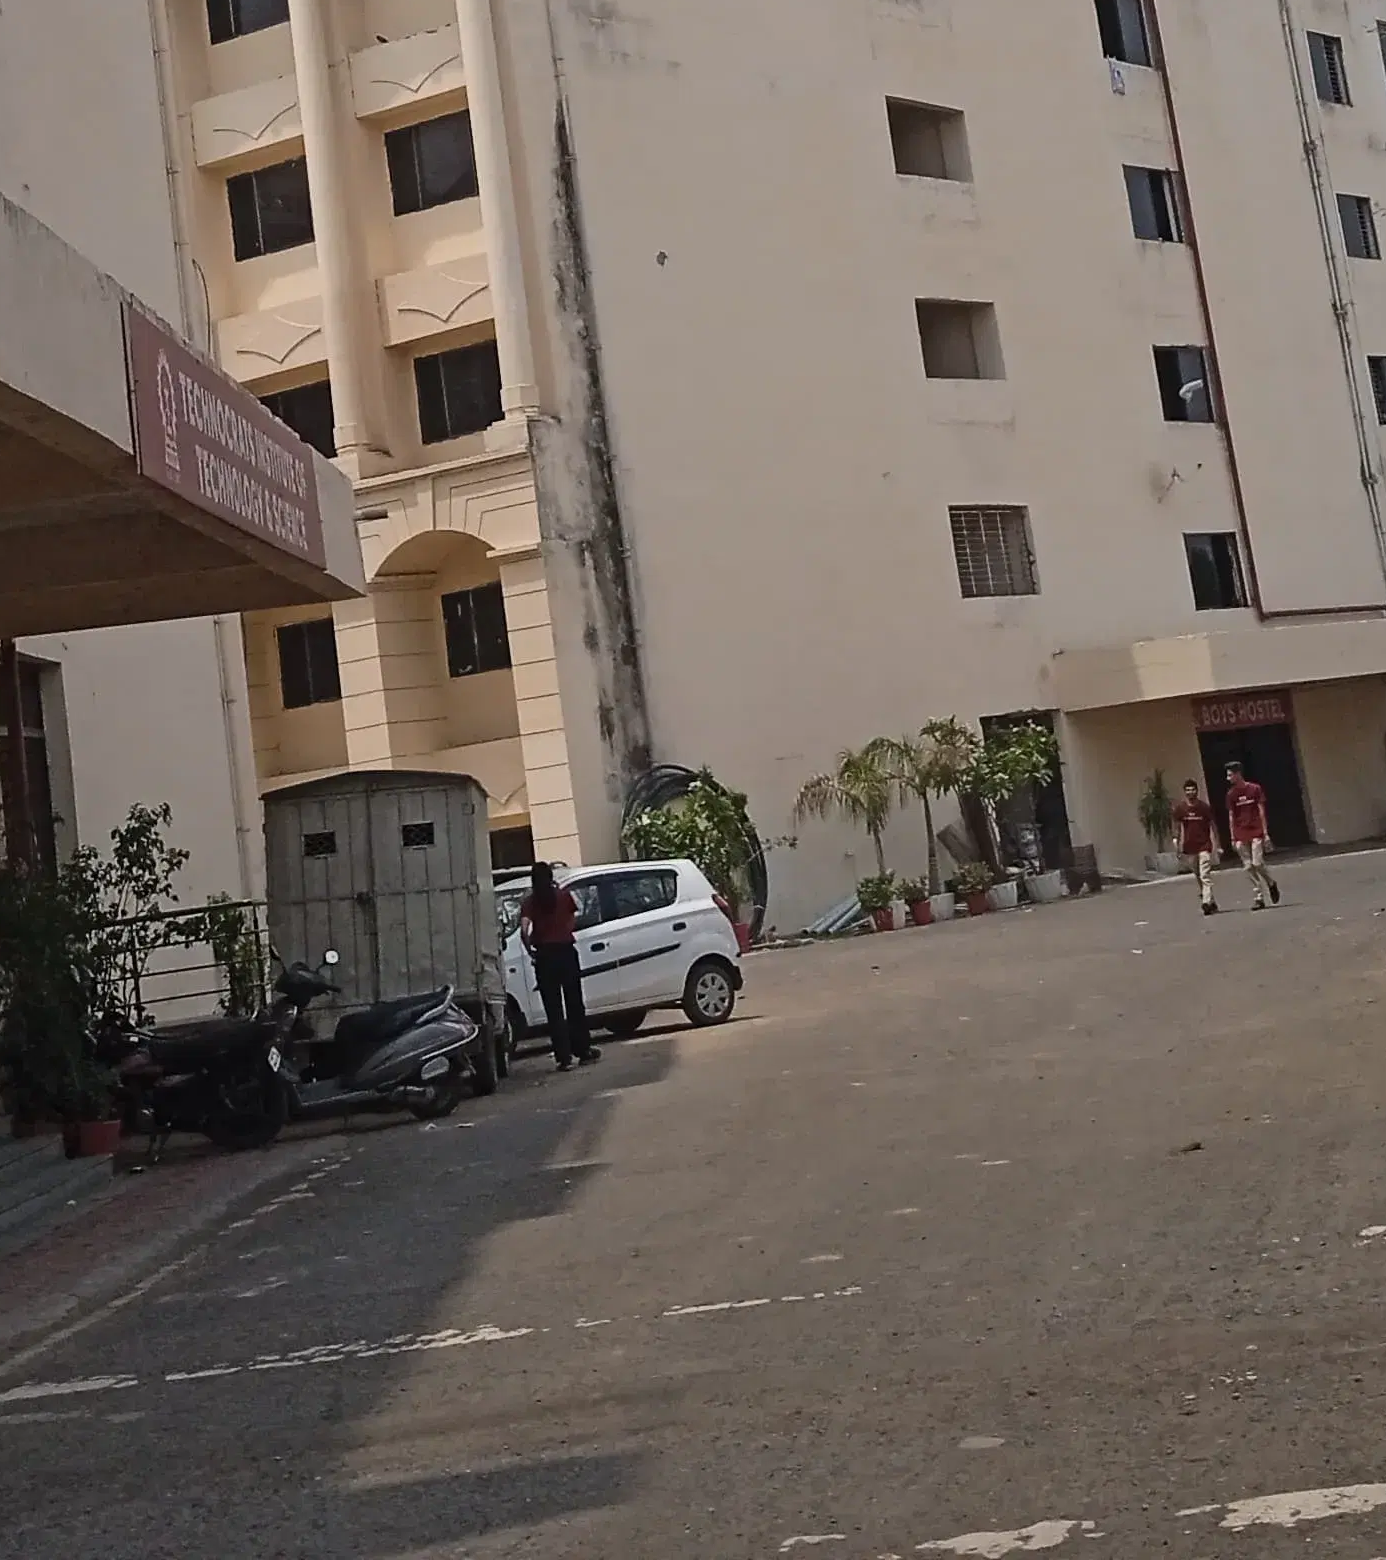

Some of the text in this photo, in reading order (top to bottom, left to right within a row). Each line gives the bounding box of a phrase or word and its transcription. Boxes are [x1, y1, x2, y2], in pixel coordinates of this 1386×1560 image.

[178, 370, 256, 467] TECHNOCRATS
[194, 443, 264, 527] TECHNOLOGY
[1200, 699, 1286, 726] BOYS HOSTEL
